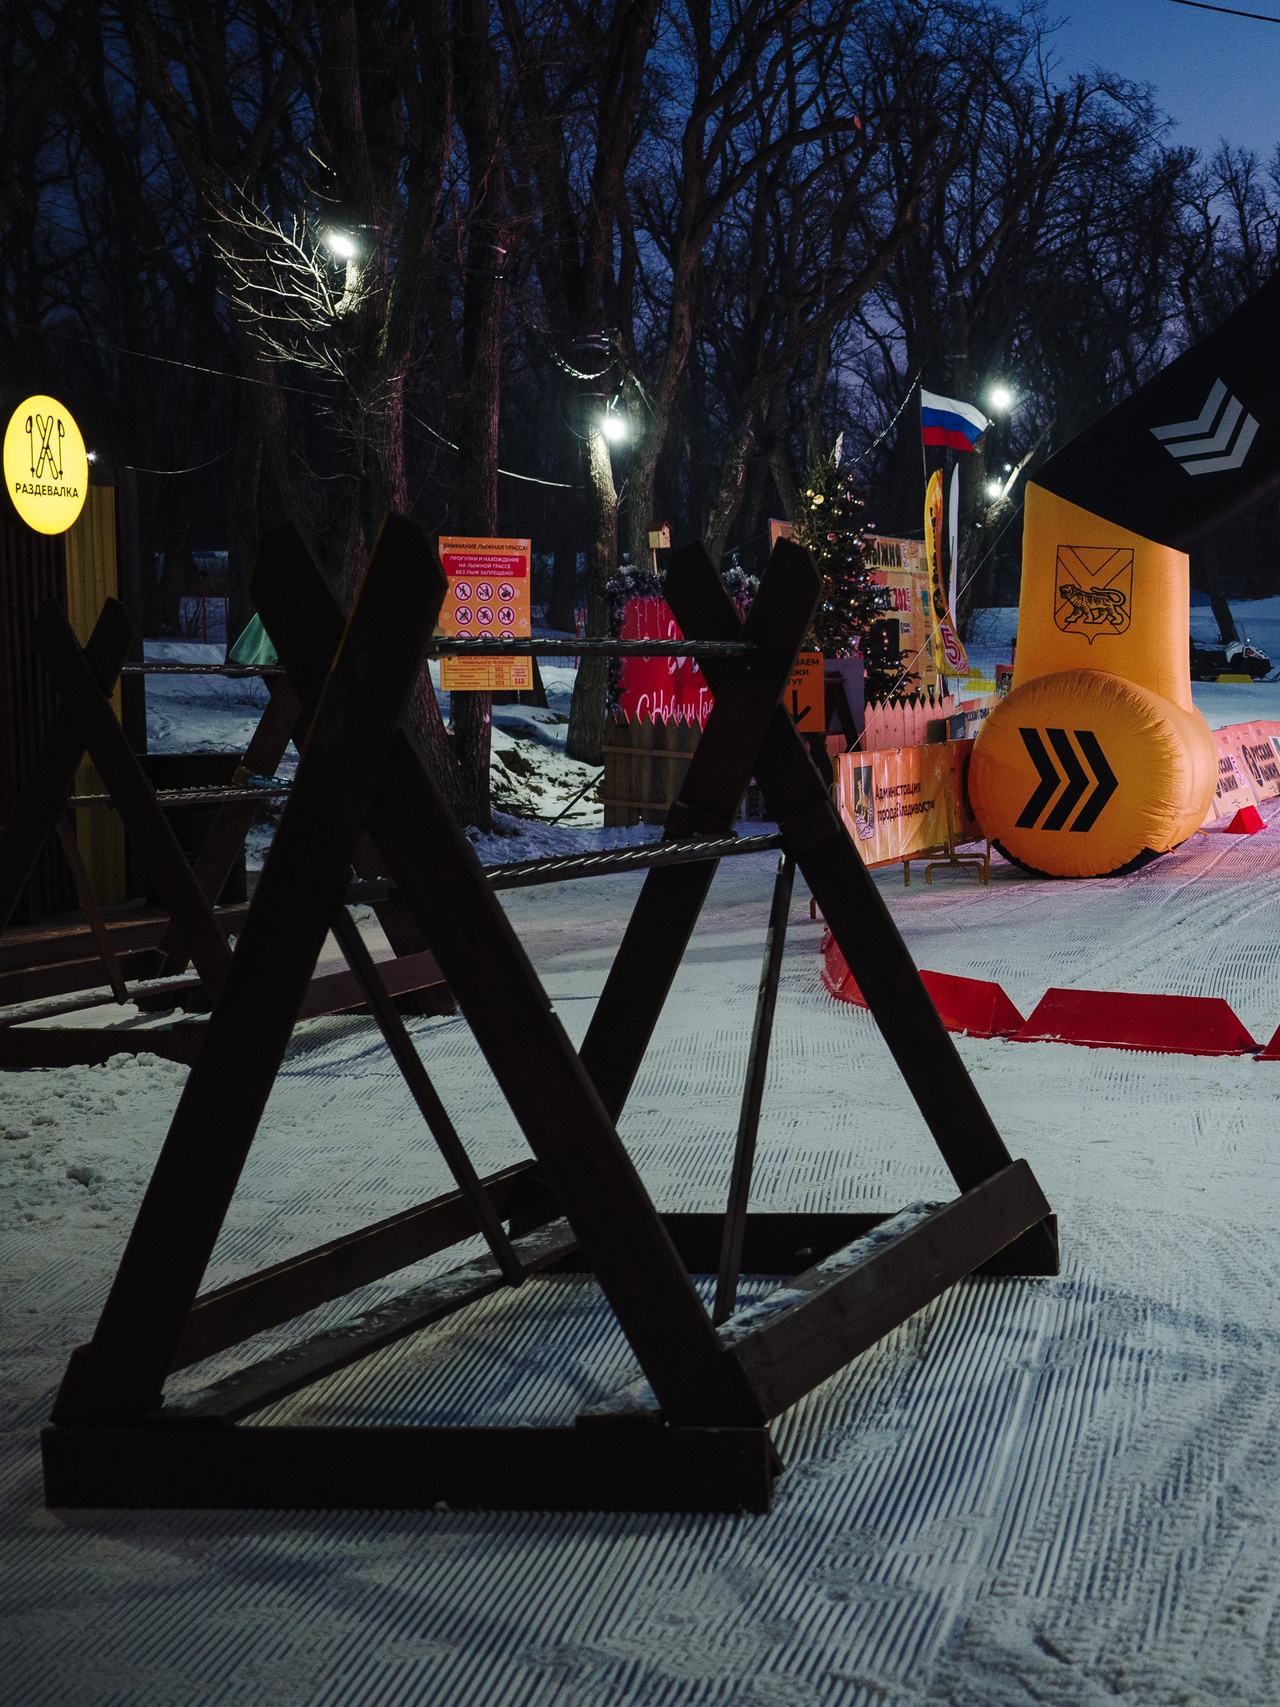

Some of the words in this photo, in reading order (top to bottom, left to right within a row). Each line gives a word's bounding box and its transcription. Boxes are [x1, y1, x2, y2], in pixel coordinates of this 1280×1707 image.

[15, 483, 79, 498] РАЗДЕВАЛКА
[1250, 742, 1275, 761] РУССКАЯ
[875, 781, 922, 801] Администрация
